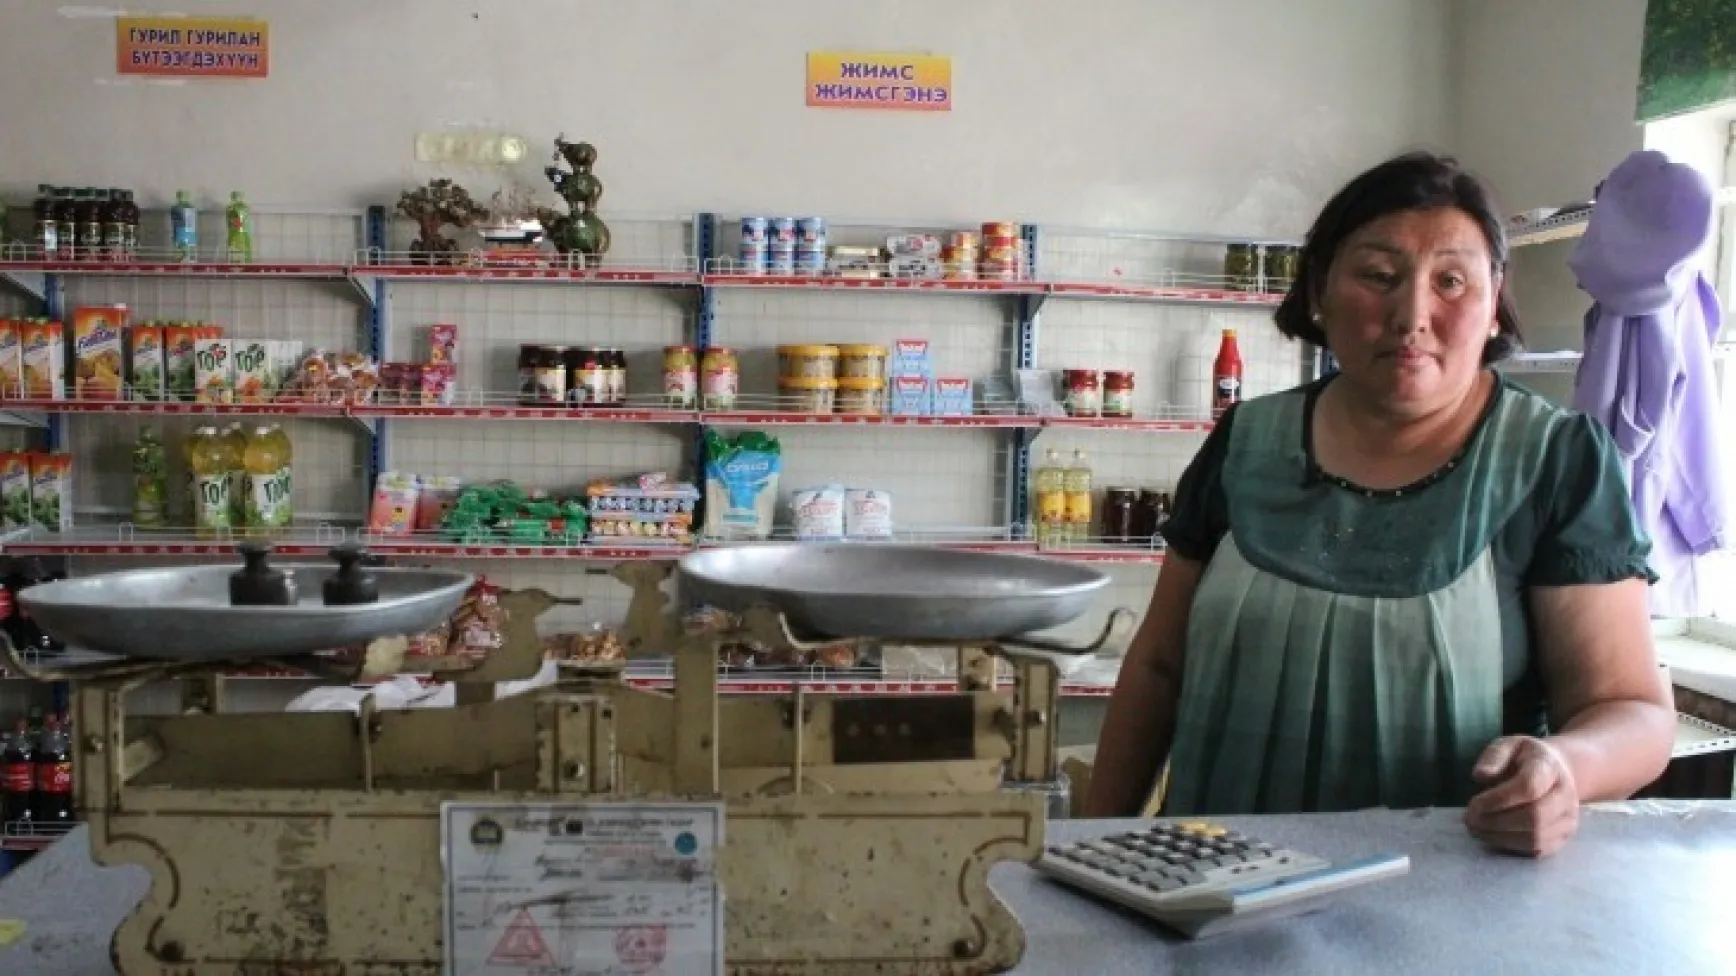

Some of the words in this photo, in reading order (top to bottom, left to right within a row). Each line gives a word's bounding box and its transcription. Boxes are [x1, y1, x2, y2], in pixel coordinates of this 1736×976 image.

[129, 26, 182, 45] ГУРИЛ
[187, 28, 261, 46] ГУРИЛАН
[840, 62, 914, 81] ЖИМС
[814, 83, 948, 103] ЖИМСГЭНЭ
